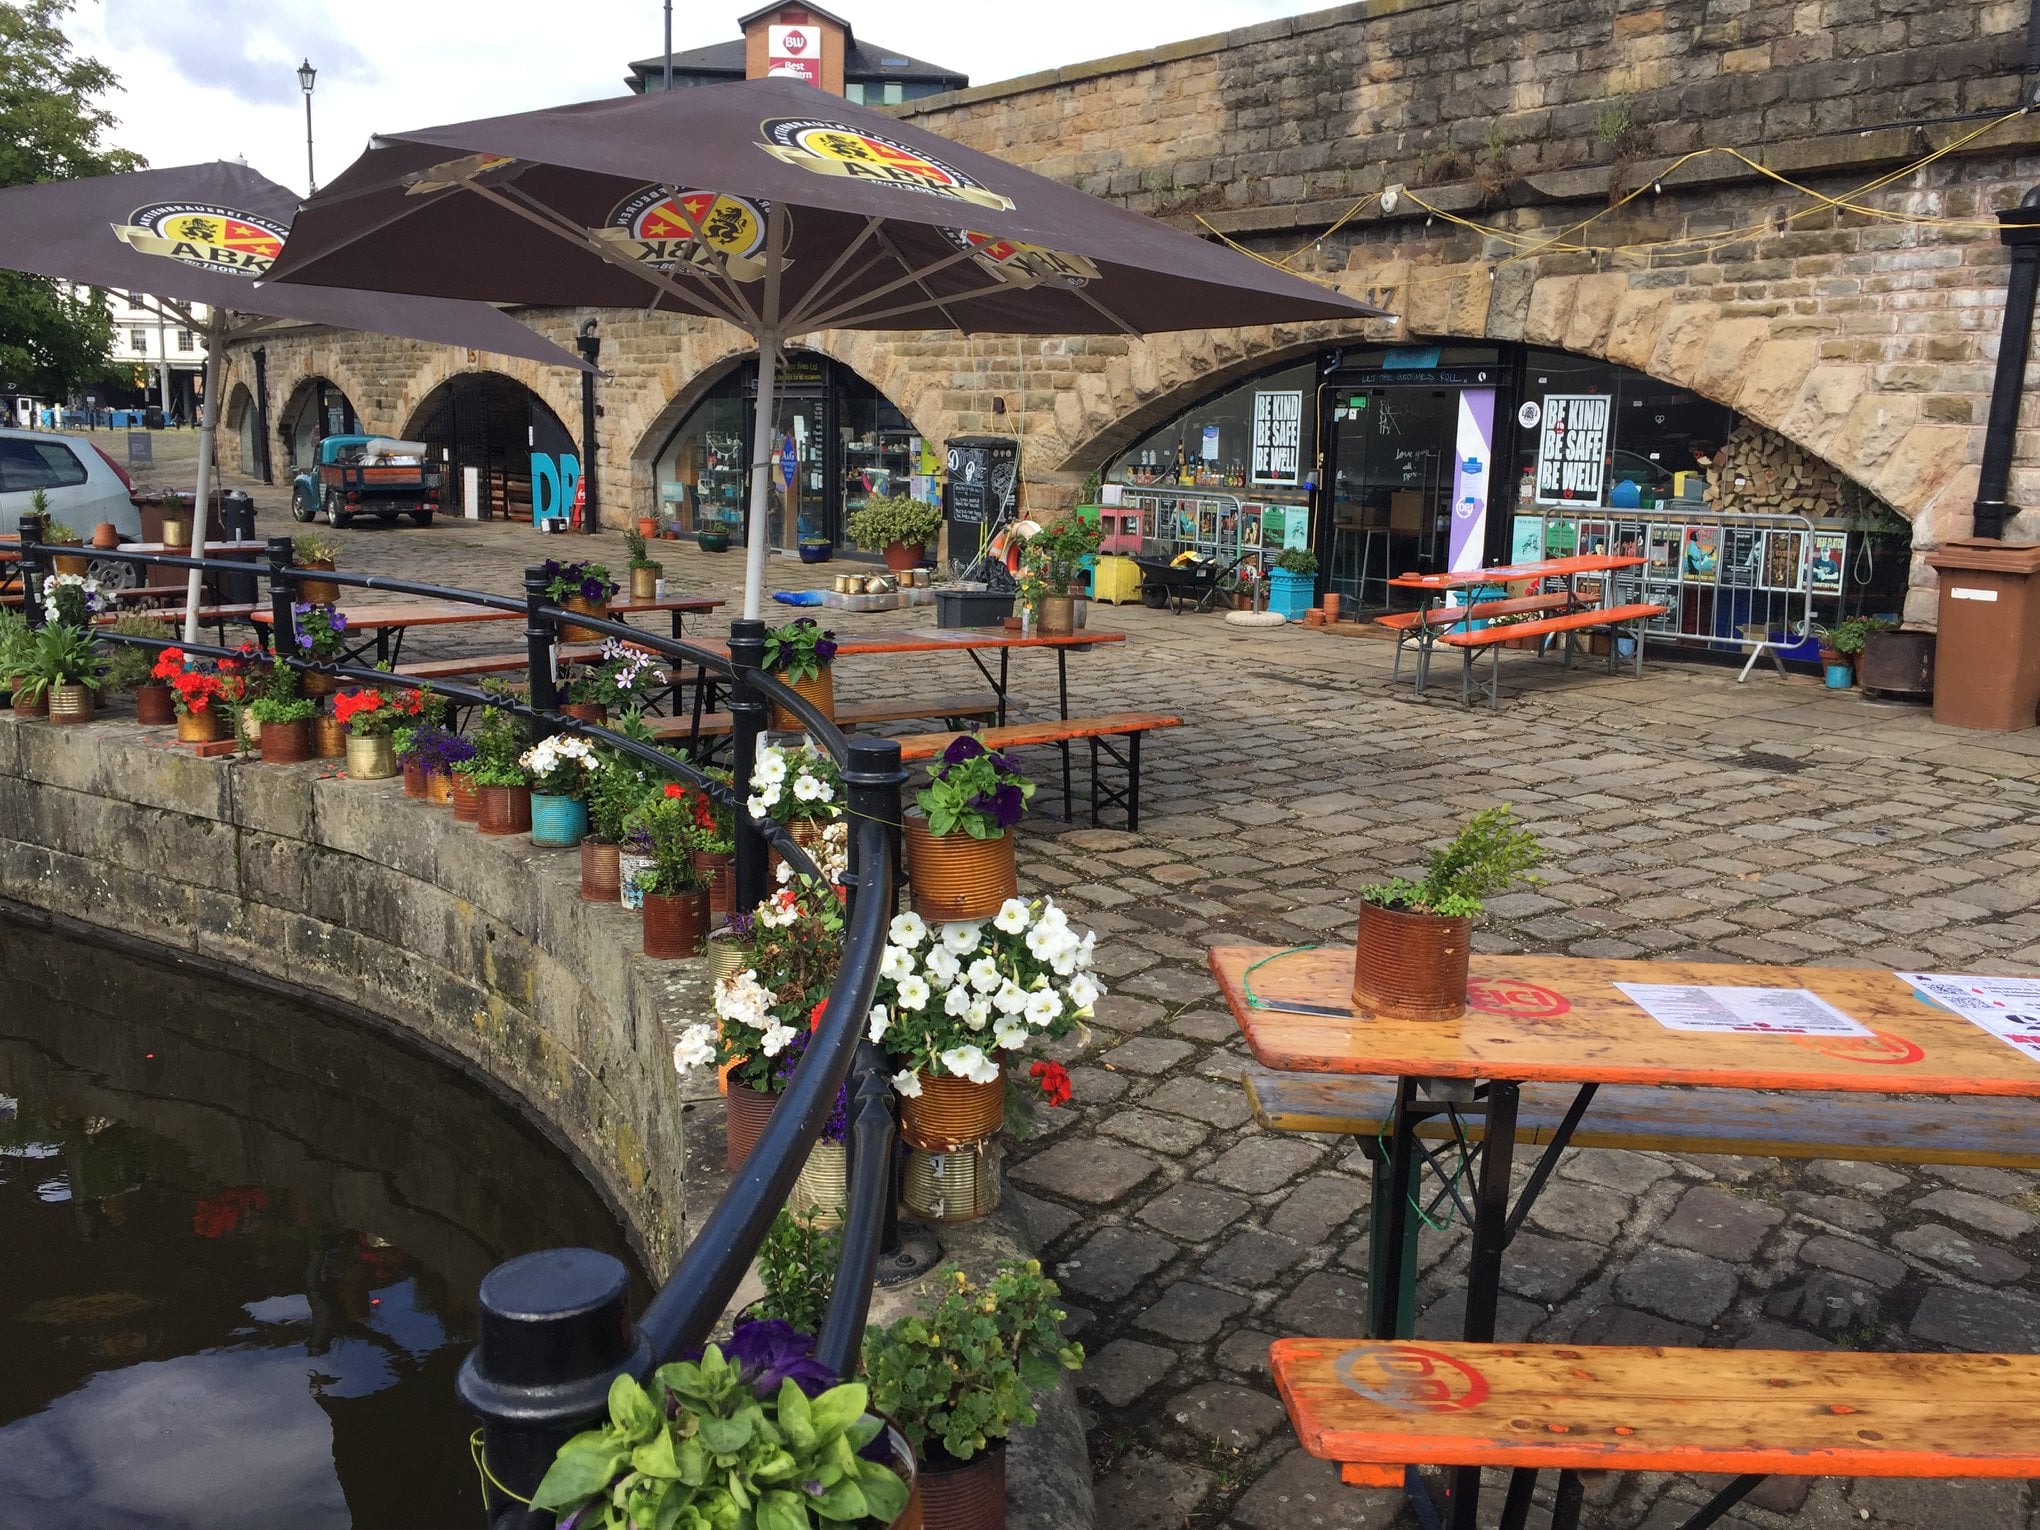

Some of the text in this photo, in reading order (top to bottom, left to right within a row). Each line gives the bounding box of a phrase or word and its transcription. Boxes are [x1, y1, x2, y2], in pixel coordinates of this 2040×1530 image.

[785, 37, 804, 48] BW
[784, 61, 805, 71] Best
[842, 160, 958, 194] ABK
[138, 205, 242, 226] AKTIENBRAUEREI
[170, 242, 276, 273] ABK
[1258, 396, 1298, 420] BE KIND
[1546, 400, 1567, 429] BE
[1567, 400, 1605, 430] KIND
[1257, 421, 1297, 447] BE SAFE
[1544, 430, 1602, 461] BE SAFE
[1256, 447, 1296, 472] BE WELL
[1541, 461, 1598, 492] BE WELL
